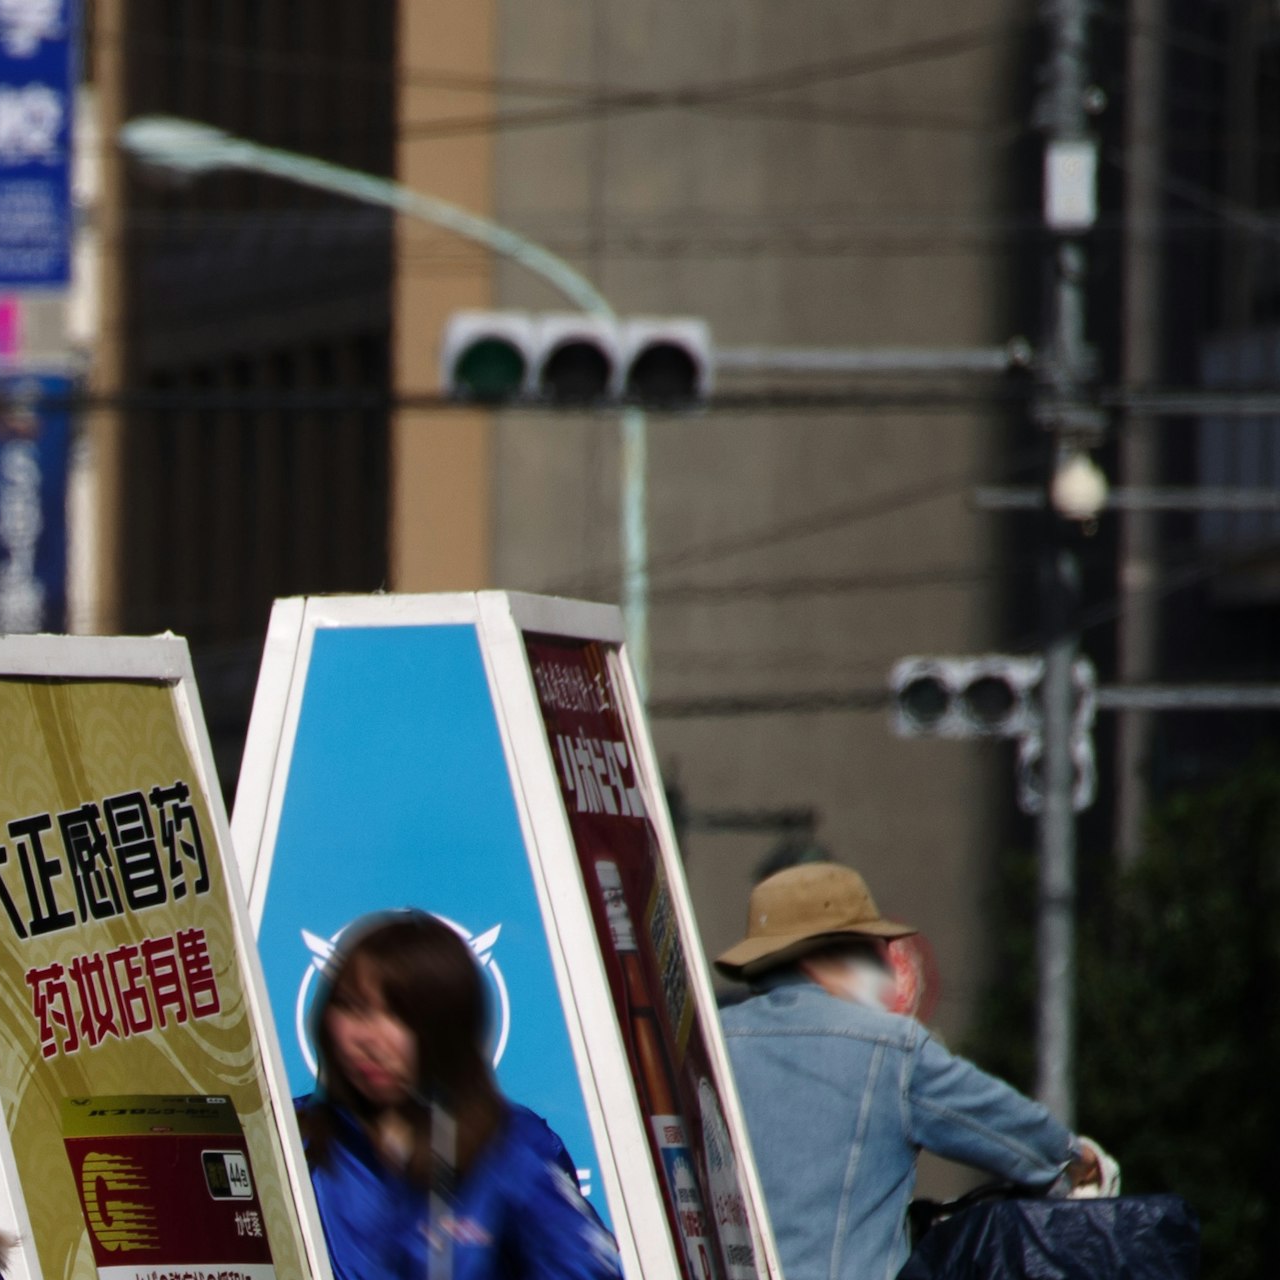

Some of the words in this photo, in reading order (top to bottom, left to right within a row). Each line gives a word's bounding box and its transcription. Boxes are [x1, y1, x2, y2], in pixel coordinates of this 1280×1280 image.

[26, 929, 221, 1060] 药妆店有售
[235, 1210, 263, 1238] かぜ薬
